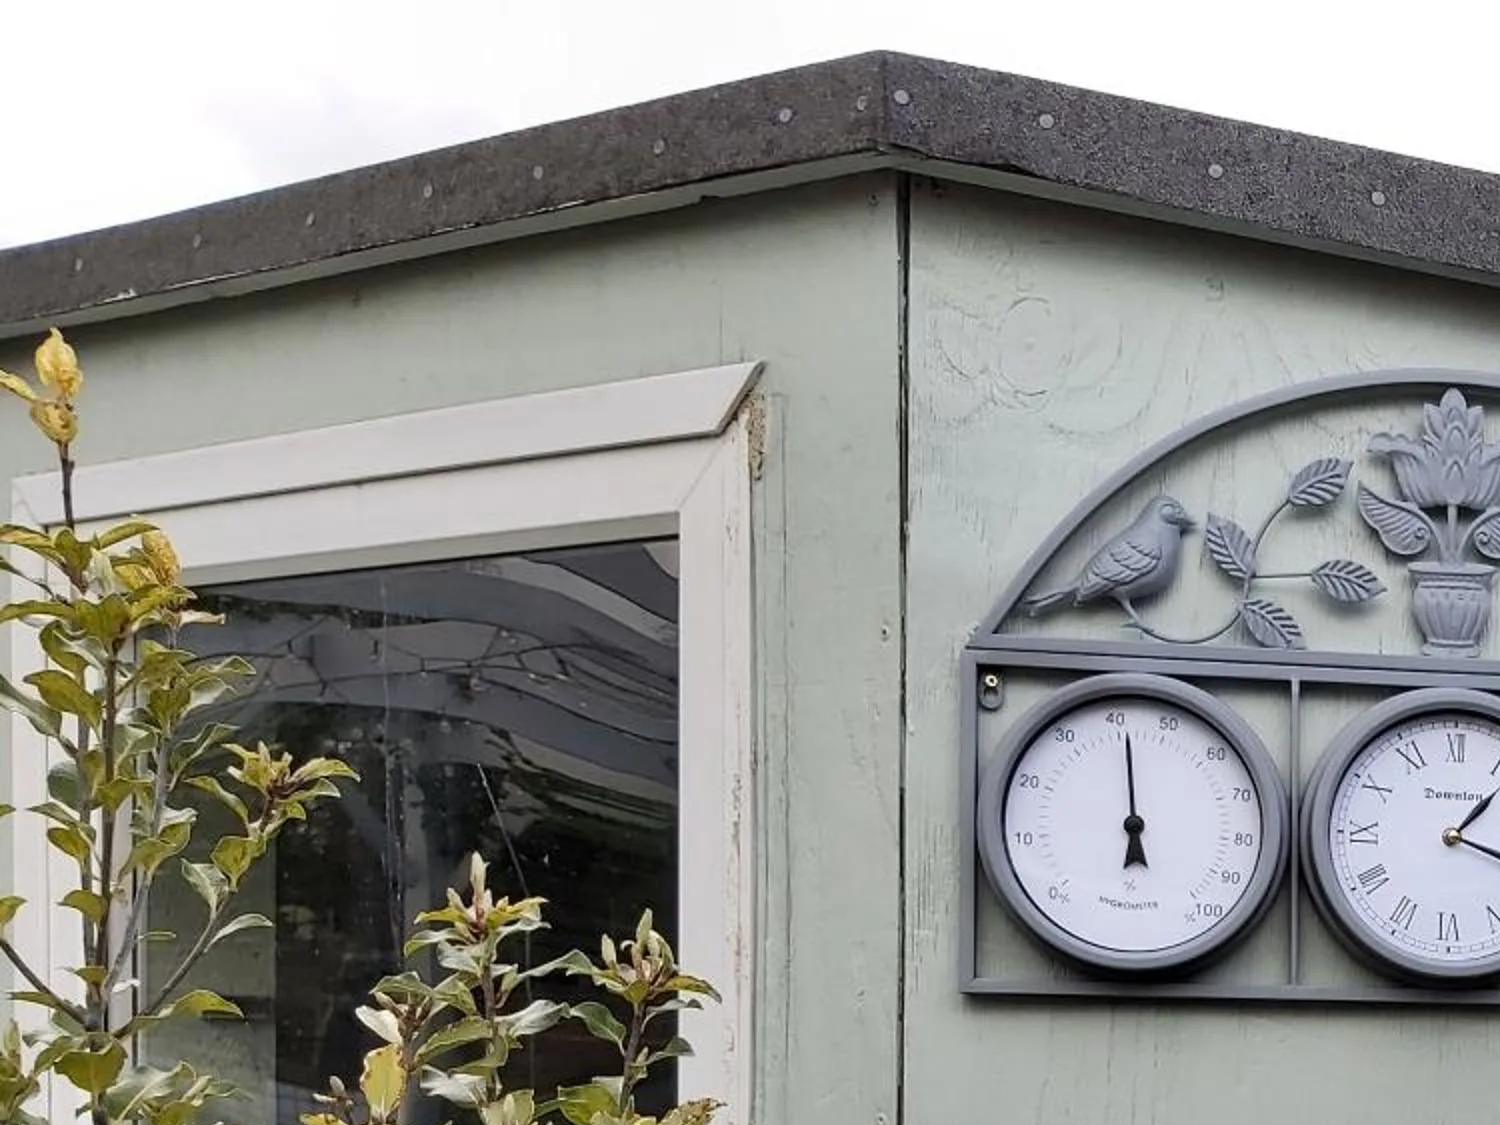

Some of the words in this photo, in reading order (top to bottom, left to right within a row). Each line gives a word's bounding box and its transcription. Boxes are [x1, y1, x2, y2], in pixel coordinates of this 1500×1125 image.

[1105, 712, 1125, 726] 40
[1159, 717, 1179, 731] 50
[1055, 729, 1075, 743] 30
[1207, 747, 1226, 761] 60
[1020, 774, 1039, 788] 20
[1232, 788, 1250, 802] 70
[1362, 773, 1392, 804] X
[1015, 832, 1033, 845] 10
[1234, 833, 1253, 847] 80
[1221, 871, 1241, 884] 90
